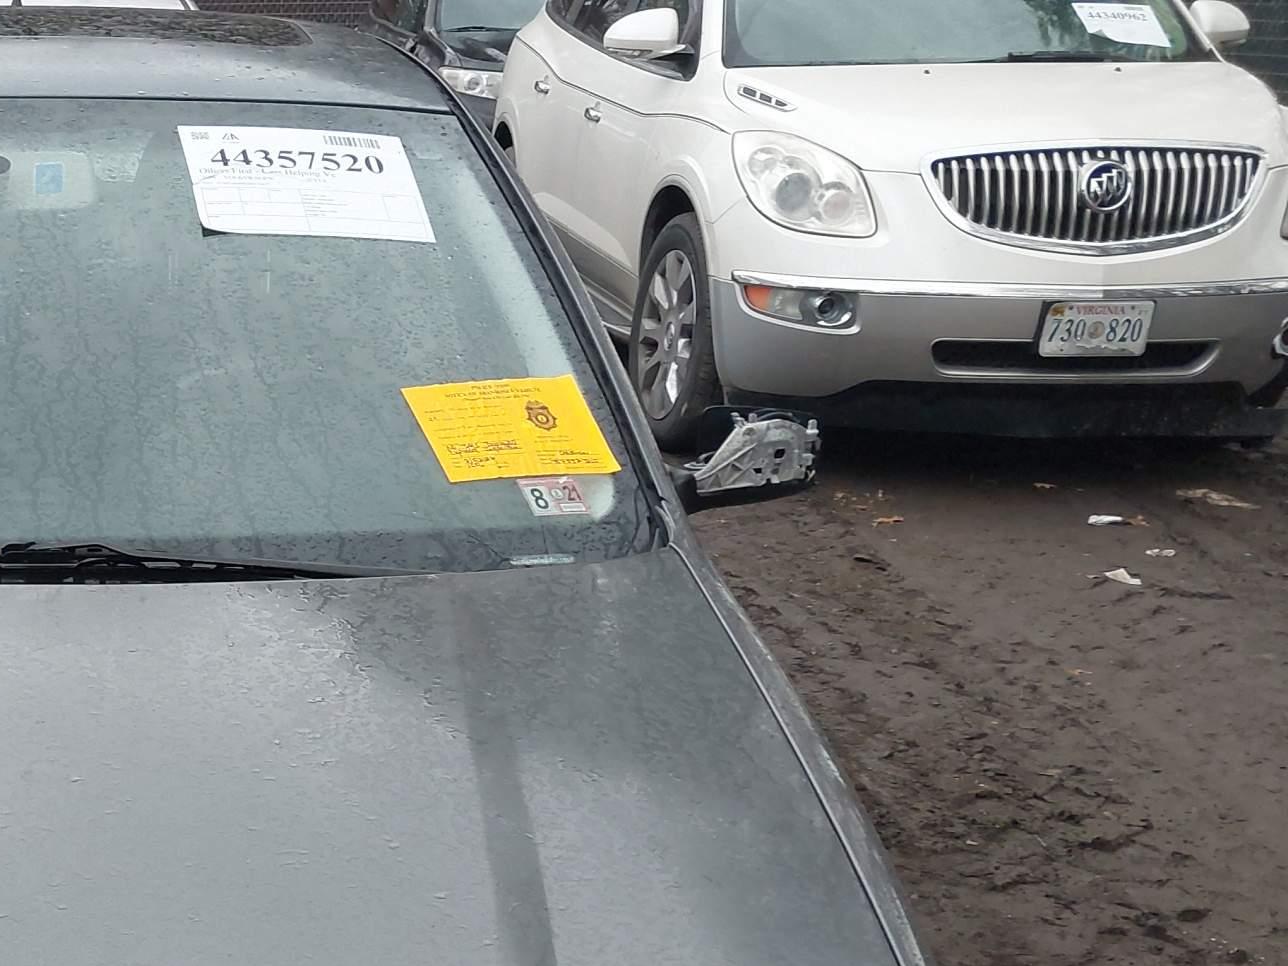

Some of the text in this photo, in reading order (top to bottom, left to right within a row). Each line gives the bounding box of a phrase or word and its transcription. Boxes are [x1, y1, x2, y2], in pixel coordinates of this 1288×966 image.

[210, 148, 384, 175] 44357520
[1076, 305, 1126, 315] VIRGINIA
[1048, 318, 1143, 343] 730 820
[530, 488, 550, 510] 8
